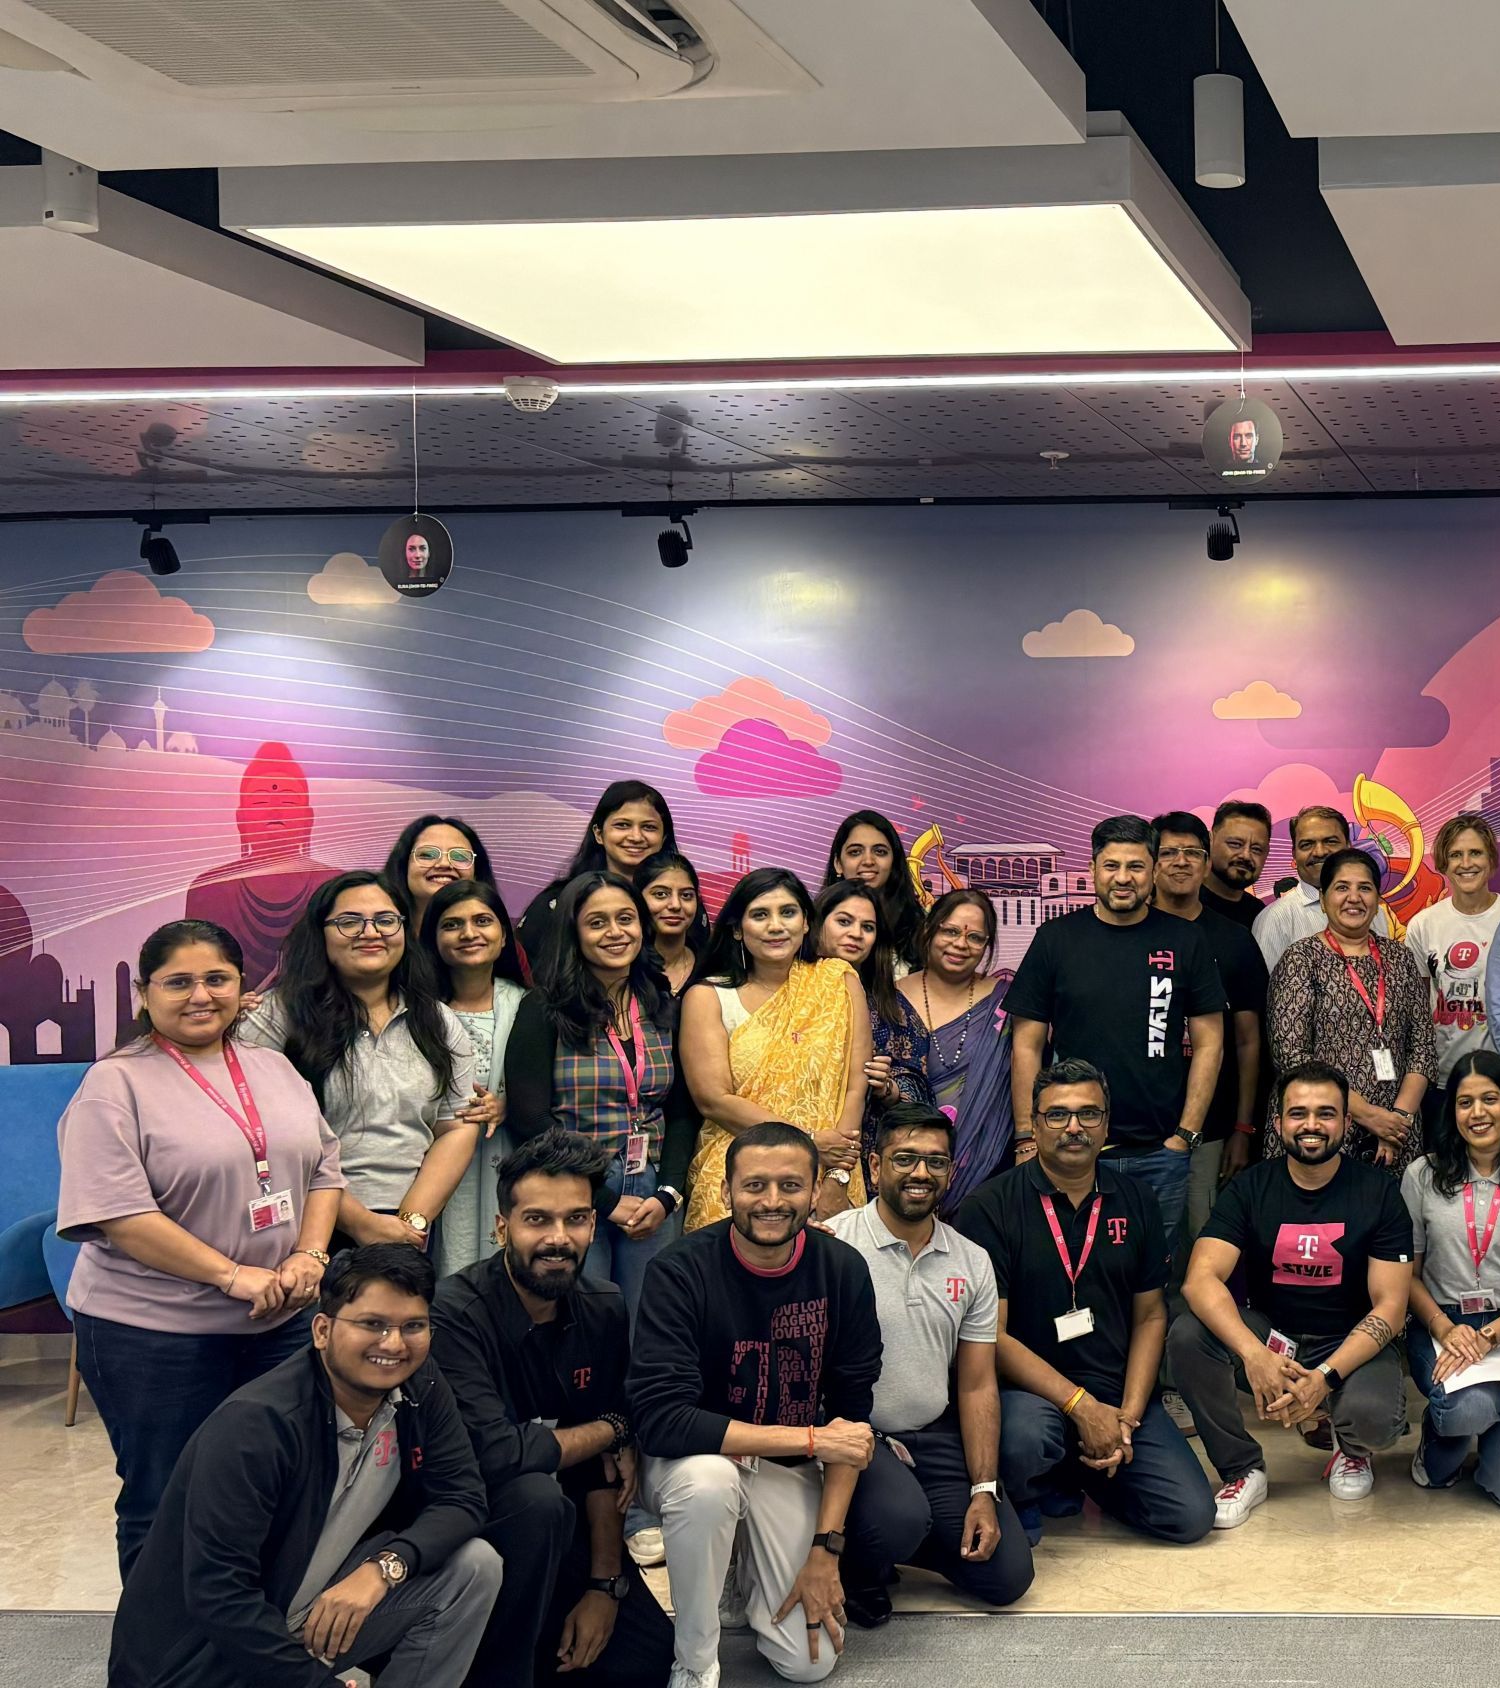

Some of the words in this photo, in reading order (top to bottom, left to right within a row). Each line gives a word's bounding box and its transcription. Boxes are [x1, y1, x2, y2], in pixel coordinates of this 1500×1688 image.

[1148, 950, 1174, 971] T
[1458, 948, 1472, 961] T
[1148, 976, 1173, 1058] STYLE
[1107, 1218, 1127, 1244] T
[1297, 1234, 1319, 1260] T
[1281, 1263, 1333, 1278] STYLE
[946, 1277, 966, 1302] T
[573, 1367, 592, 1389] T
